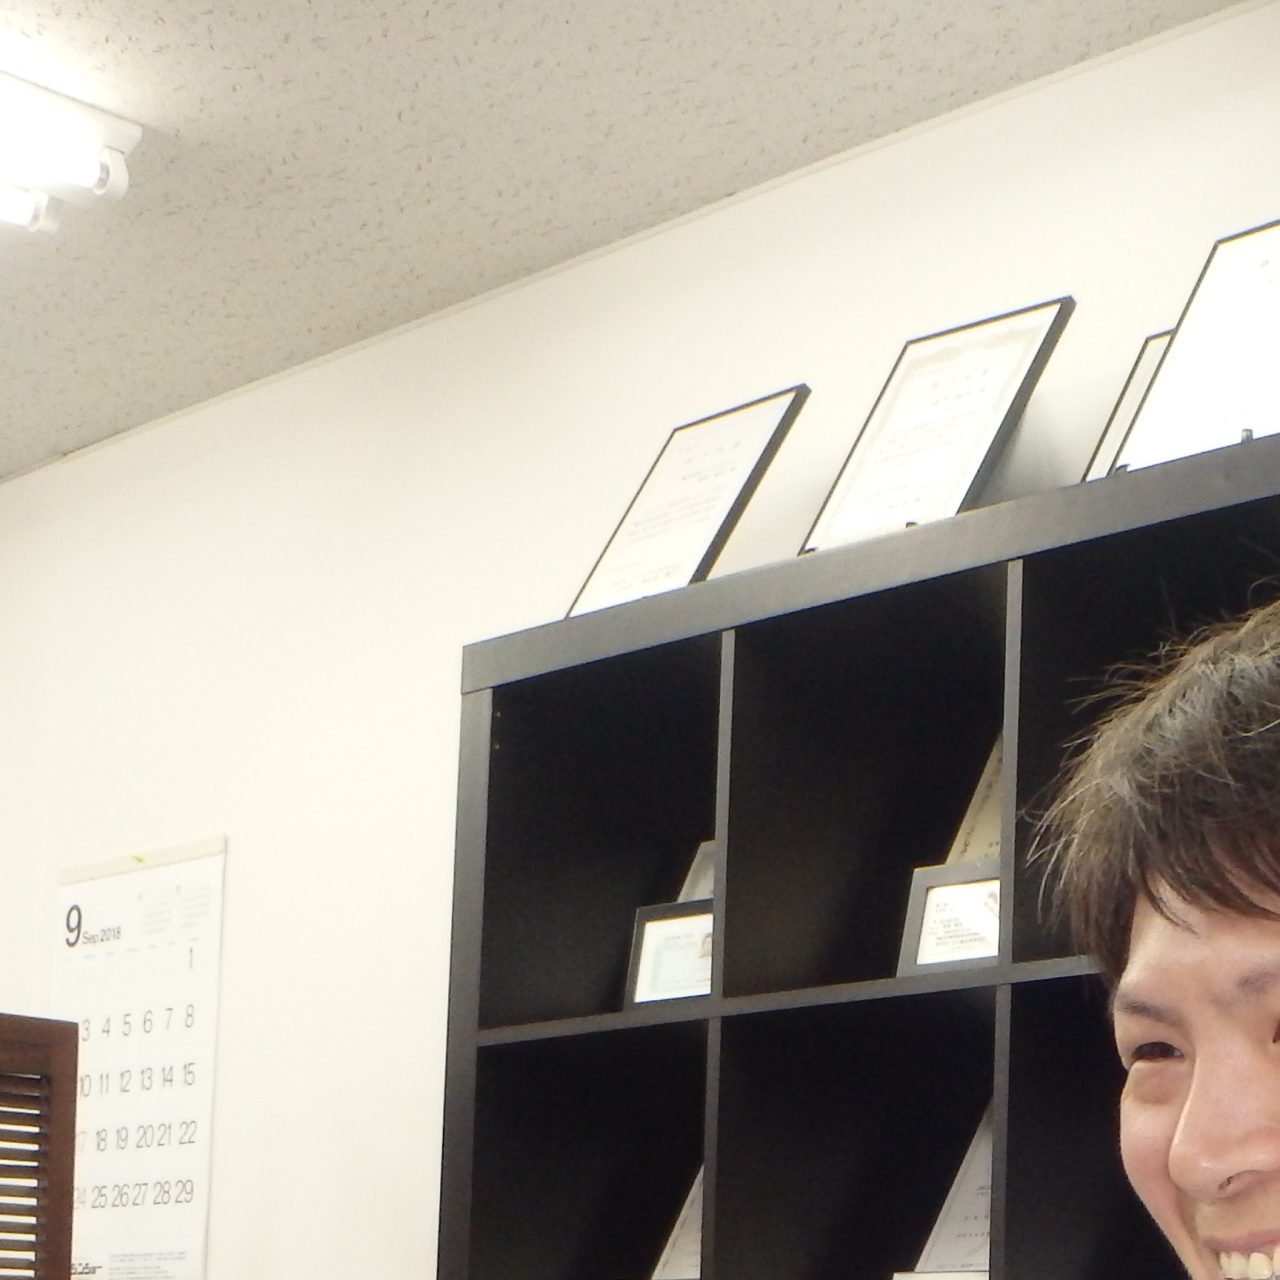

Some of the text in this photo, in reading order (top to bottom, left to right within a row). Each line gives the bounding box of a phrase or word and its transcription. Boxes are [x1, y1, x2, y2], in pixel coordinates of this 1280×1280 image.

[66, 904, 121, 947] 9 Sep 2018
[188, 947, 194, 969] 1
[81, 1004, 195, 1042] 3 4 5 6 7 8
[79, 1062, 196, 1098] 10 11 12 13 14 15
[96, 1129, 108, 1152] 18
[116, 1126, 129, 1150] 19
[136, 1124, 155, 1148] 20
[157, 1123, 172, 1147] 21
[179, 1120, 197, 1145] 22
[91, 1185, 108, 1209] 25
[112, 1183, 130, 1208] 26
[132, 1182, 149, 1206] 27
[153, 1180, 171, 1205] 28
[175, 1179, 194, 1204] 29
